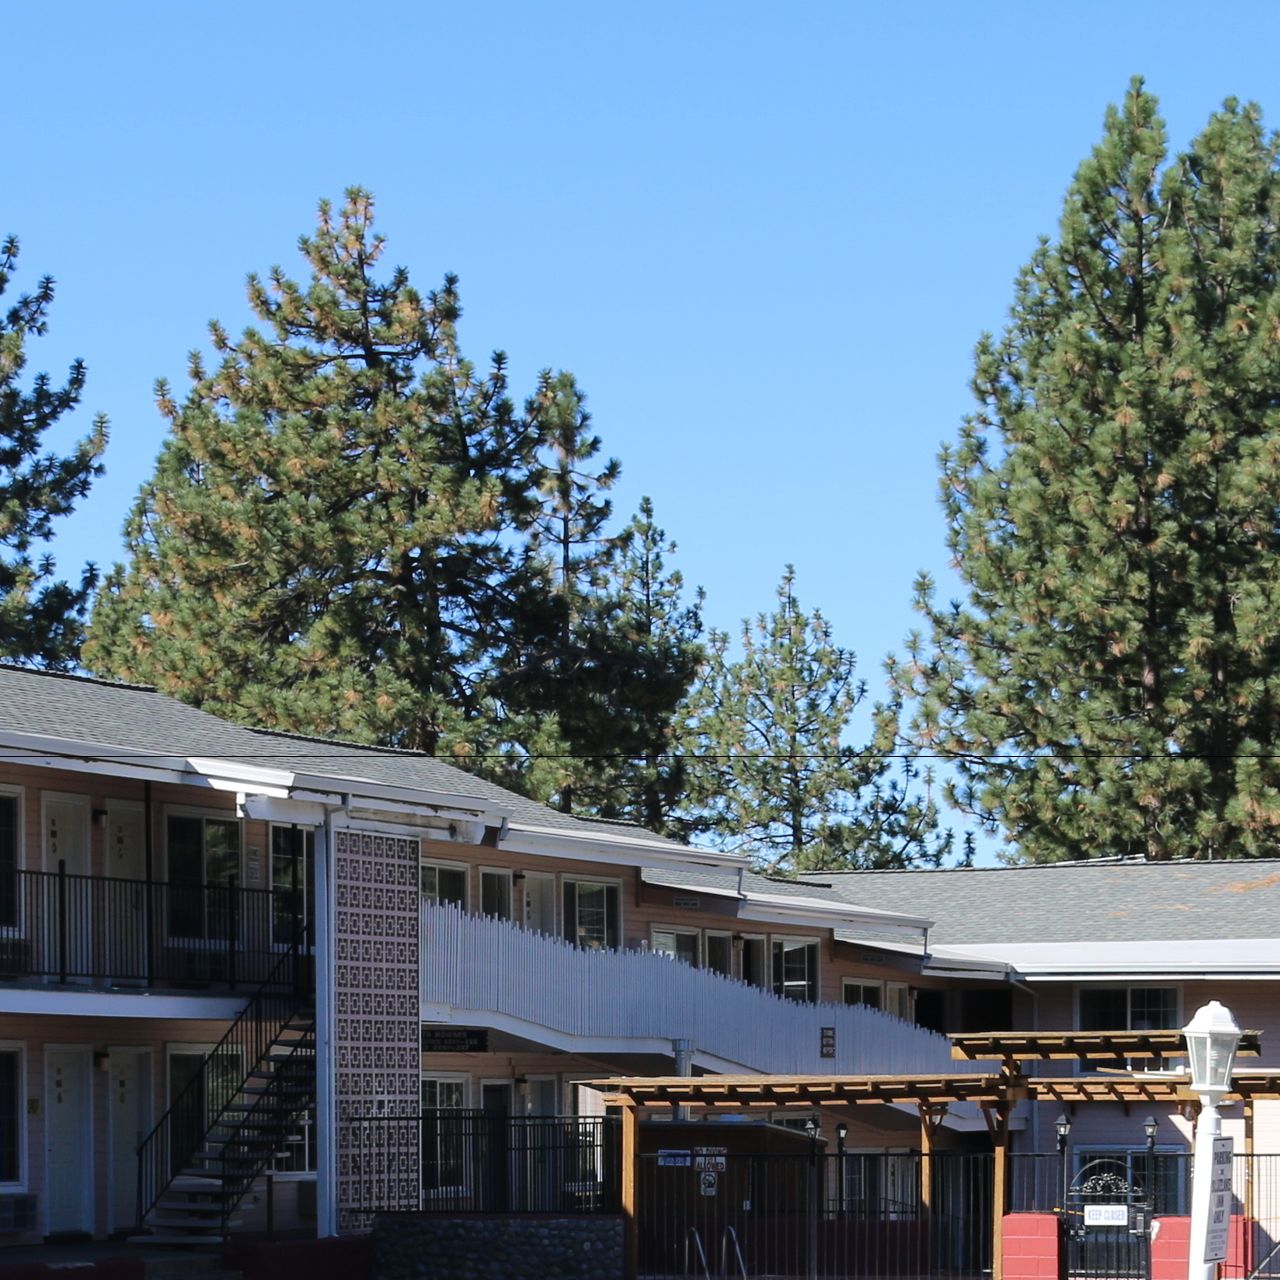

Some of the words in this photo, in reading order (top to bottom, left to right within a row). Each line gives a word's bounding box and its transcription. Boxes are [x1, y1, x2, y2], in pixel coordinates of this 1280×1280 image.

[1214, 1151, 1232, 1165] PARKING
[1088, 1209, 1102, 1220] KEEP
[1104, 1209, 1125, 1220] CLOSED
